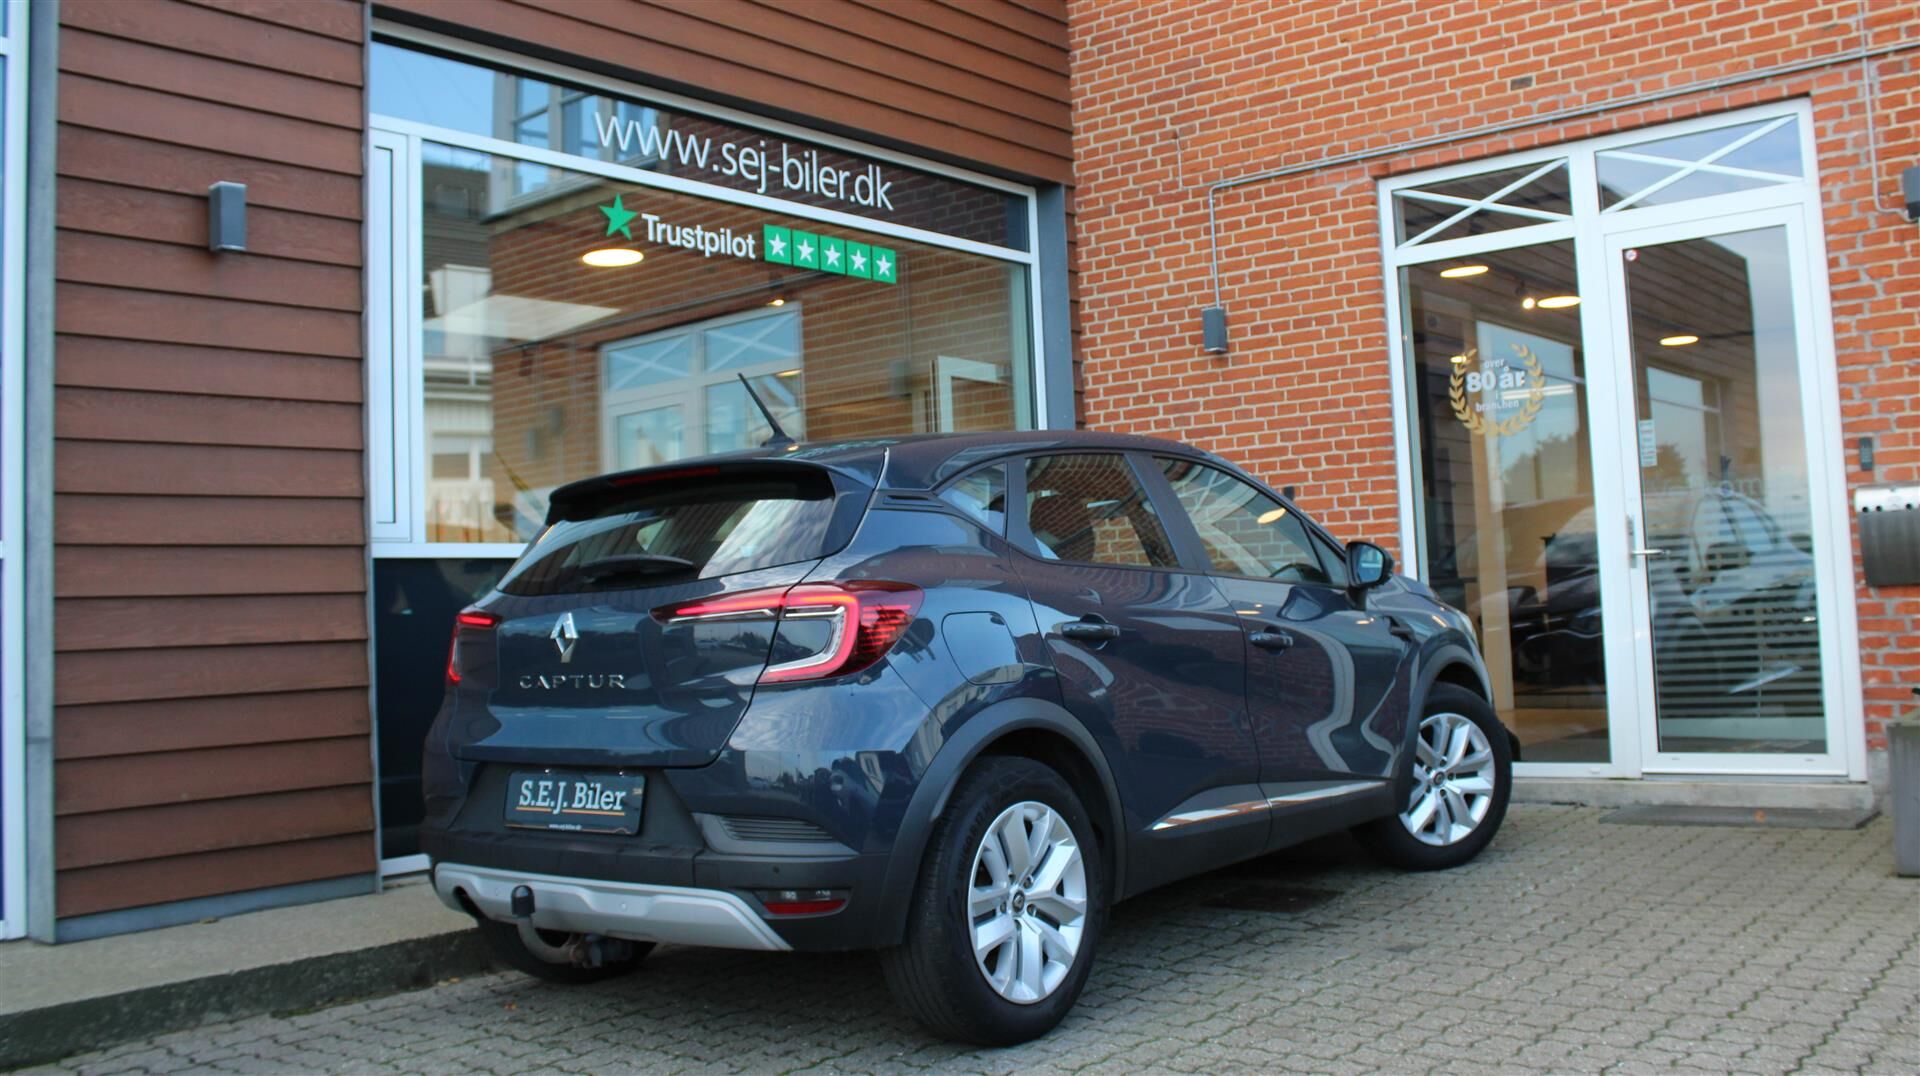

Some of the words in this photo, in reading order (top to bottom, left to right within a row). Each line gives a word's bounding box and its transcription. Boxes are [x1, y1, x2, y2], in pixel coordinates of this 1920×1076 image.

[594, 111, 895, 211] www.sej-biler.dk
[641, 212, 756, 259] Trustpilot
[1483, 358, 1505, 368] over
[1466, 371, 1496, 393] 80
[1499, 366, 1525, 389] år
[519, 674, 625, 690] CAPTUR
[519, 780, 567, 815] S.E.J.
[572, 782, 626, 811] Biler
